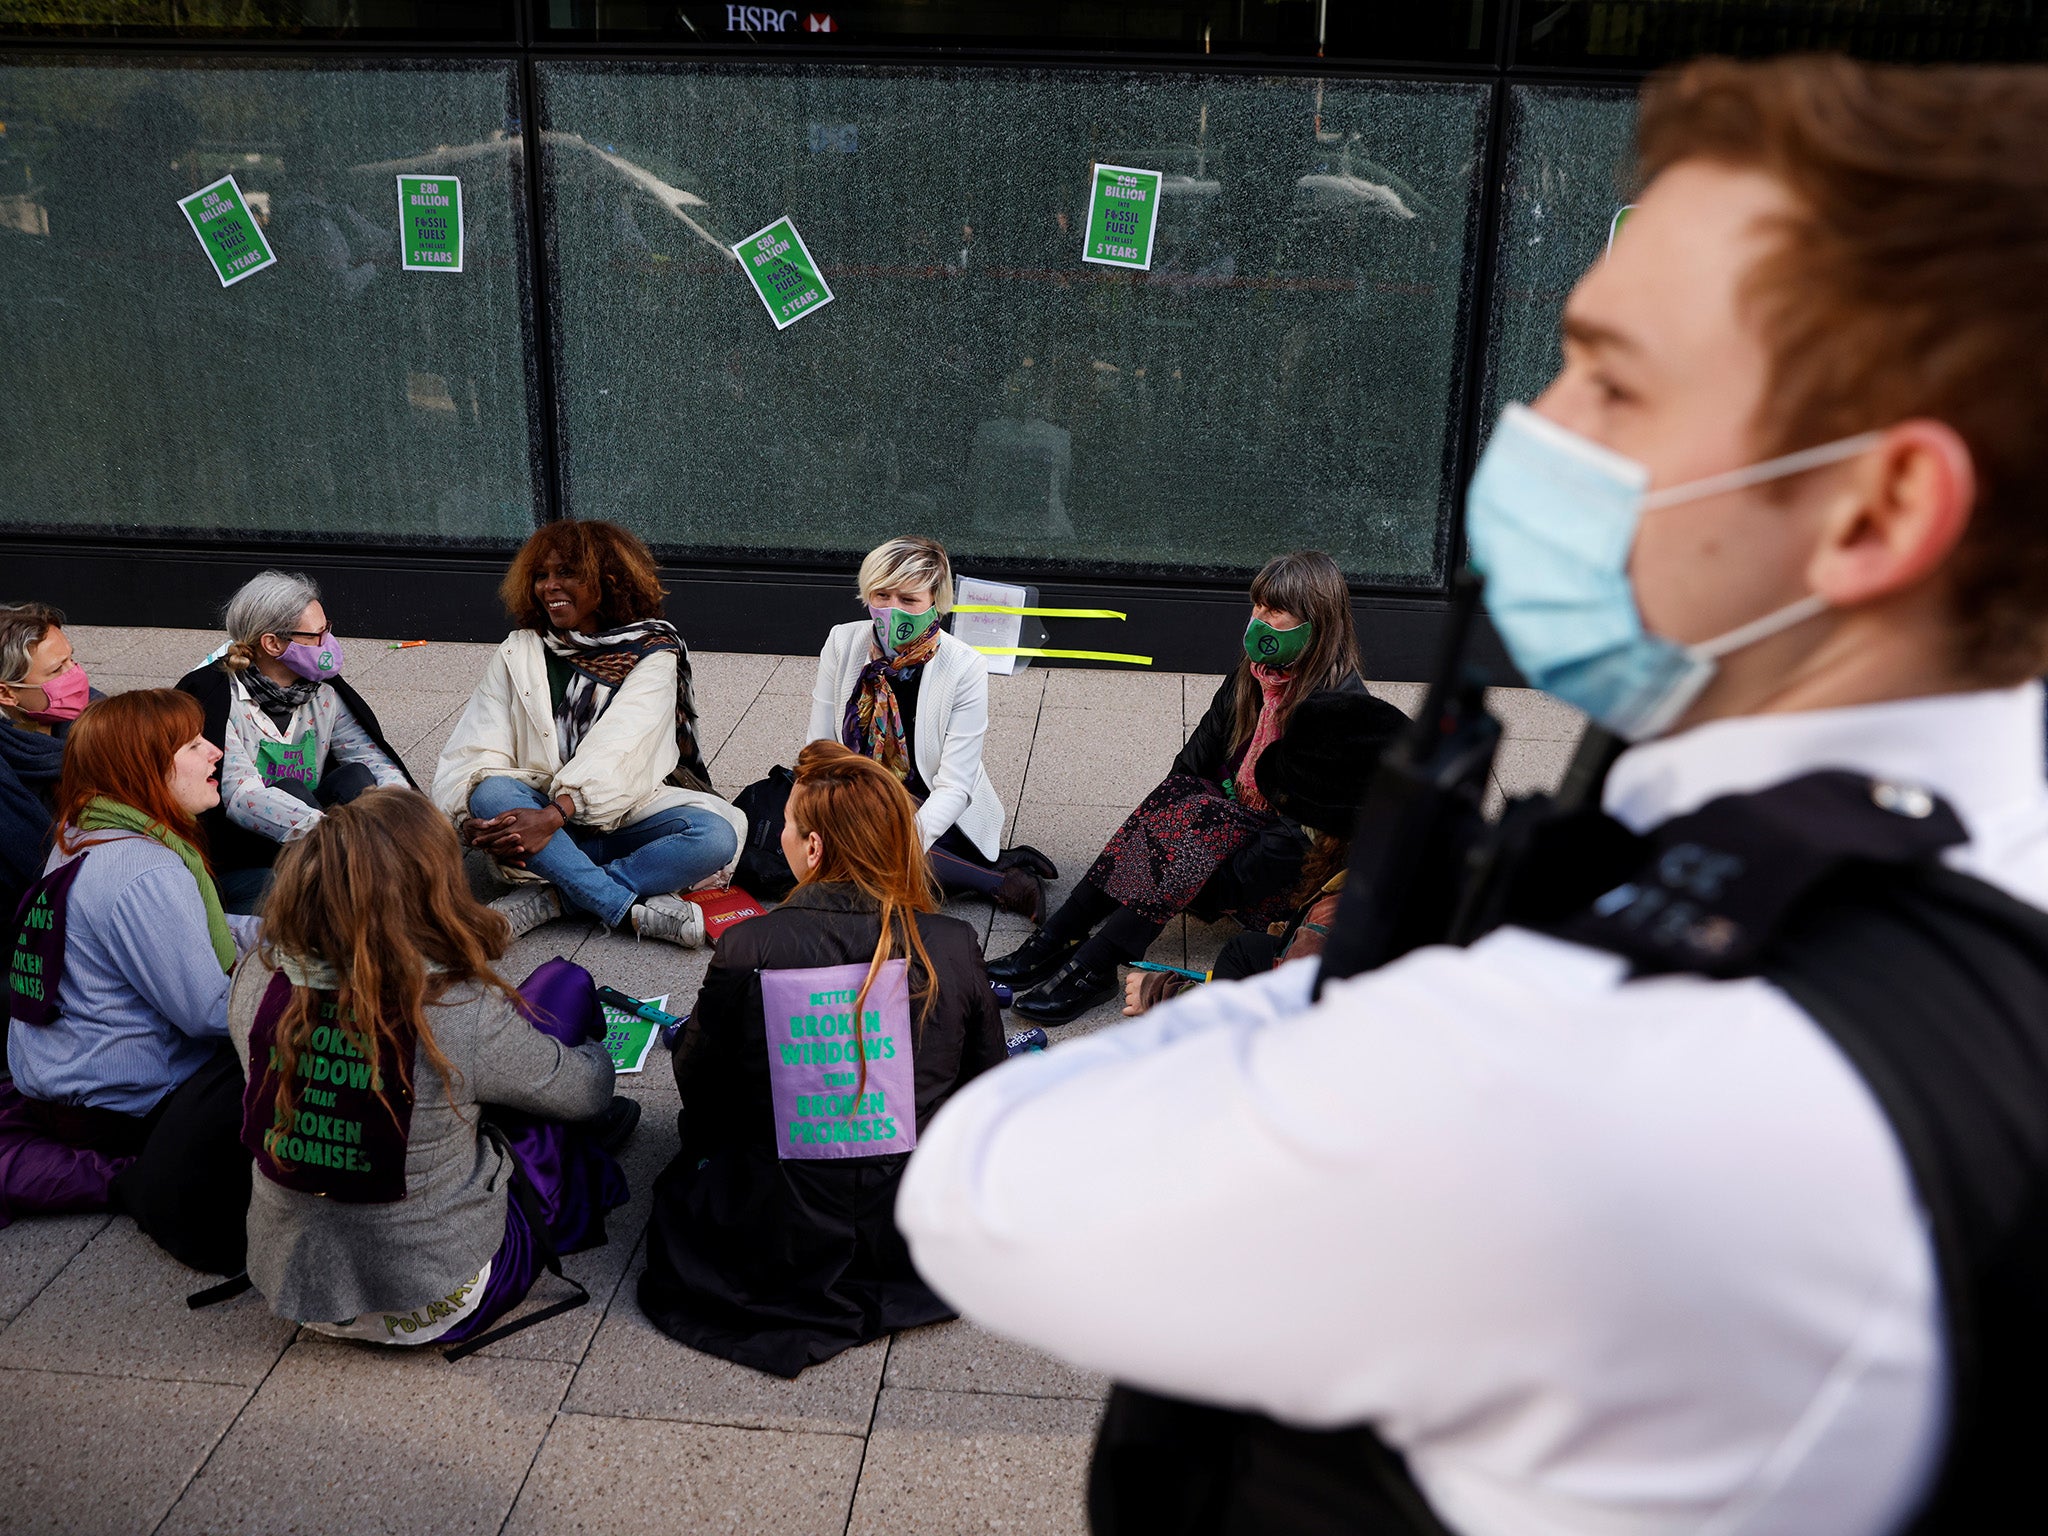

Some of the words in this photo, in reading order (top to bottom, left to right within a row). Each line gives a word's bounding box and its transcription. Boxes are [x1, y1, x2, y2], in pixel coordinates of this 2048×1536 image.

[726, 4, 797, 32] HSBC
[419, 183, 438, 195] £80
[1117, 176, 1137, 188] £80
[201, 192, 219, 209] £80
[410, 195, 448, 207] BILLION
[1105, 186, 1145, 202] BILLION
[199, 199, 234, 223] BILLION
[418, 230, 445, 240] FUELS
[1105, 222, 1135, 235] FUELS
[220, 232, 246, 251] FUELS
[756, 235, 775, 251] £80
[414, 251, 420, 262] 5
[421, 252, 451, 263] YEARS
[753, 240, 790, 266] BILLION
[1096, 244, 1103, 254] 5
[1105, 245, 1137, 259] YEARS
[226, 264, 235, 274] 5
[231, 250, 261, 270] YEARS
[775, 273, 802, 293] FUELS
[781, 306, 790, 316] 5
[787, 289, 818, 311] YEARS
[12, 949, 43, 976] OKEN
[605, 1015, 642, 1024] LION
[608, 1032, 631, 1041] SIL
[600, 1041, 624, 1050] ELS
[781, 1038, 895, 1065] WINDOWS
[269, 1045, 385, 1092] WNDOWS
[824, 1074, 855, 1086] THAN
[798, 1093, 885, 1117] BROKEN
[791, 1119, 896, 1144] PROMISES
[264, 1128, 372, 1173] PROMISES
